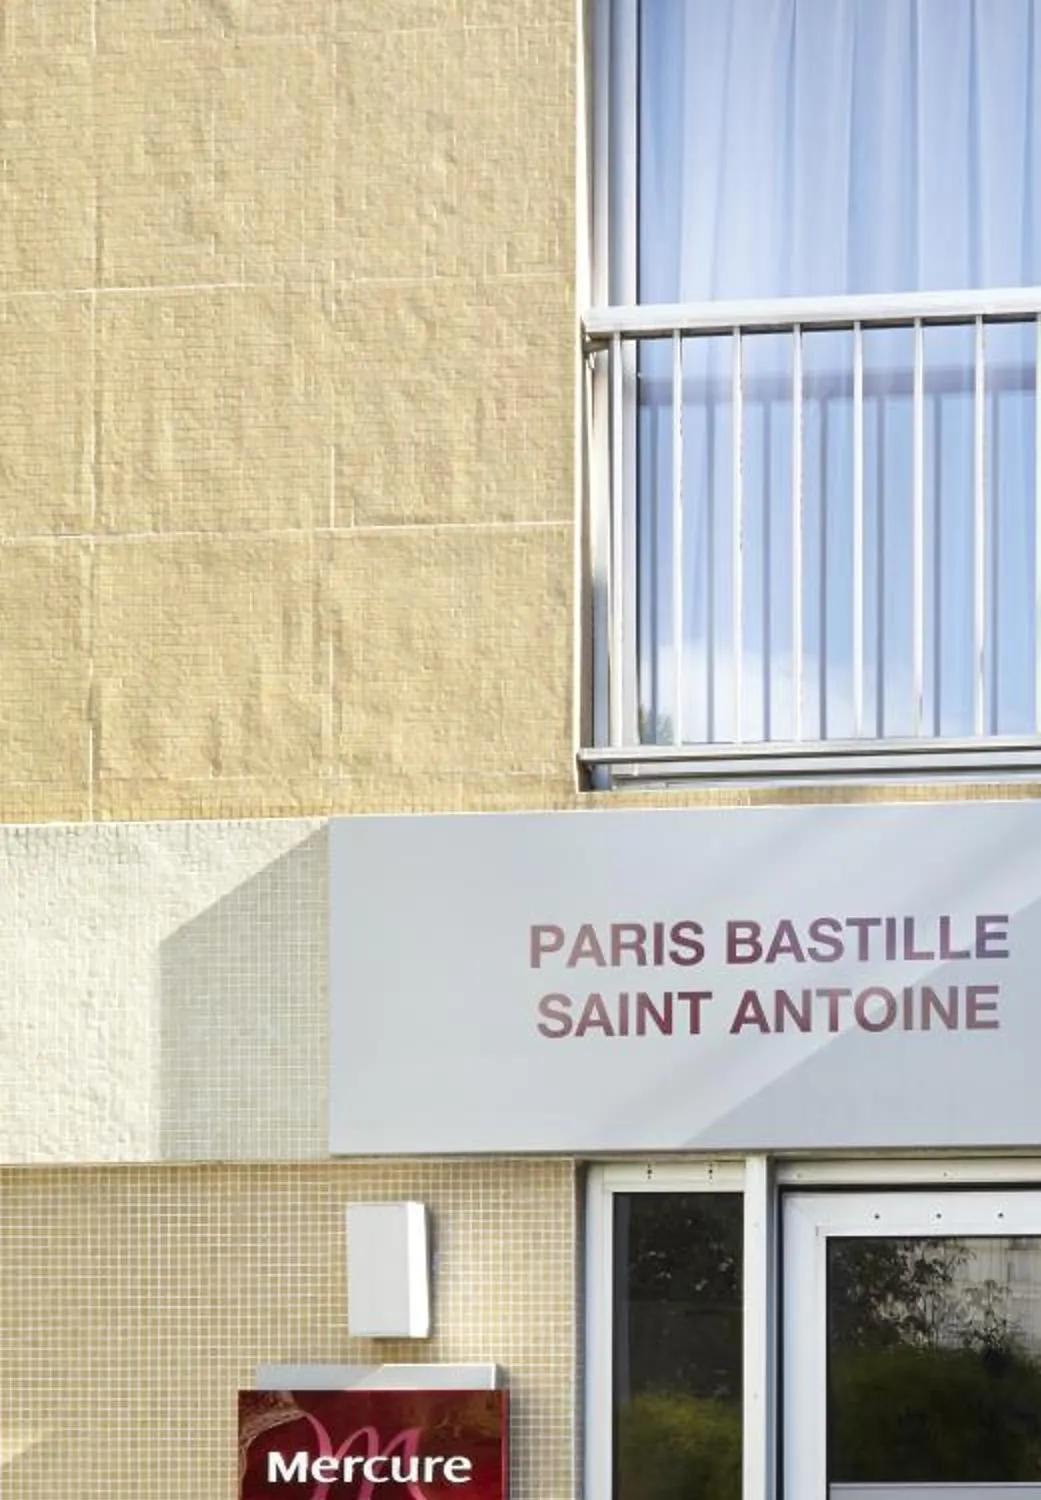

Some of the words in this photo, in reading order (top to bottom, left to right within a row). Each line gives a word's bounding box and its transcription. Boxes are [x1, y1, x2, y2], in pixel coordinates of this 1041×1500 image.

[529, 919, 705, 969] PARIS
[725, 914, 1011, 965] BASTILLE
[537, 991, 713, 1039] SAINT
[729, 985, 1001, 1035] ANTOINE
[267, 1450, 473, 1484] Mercure
